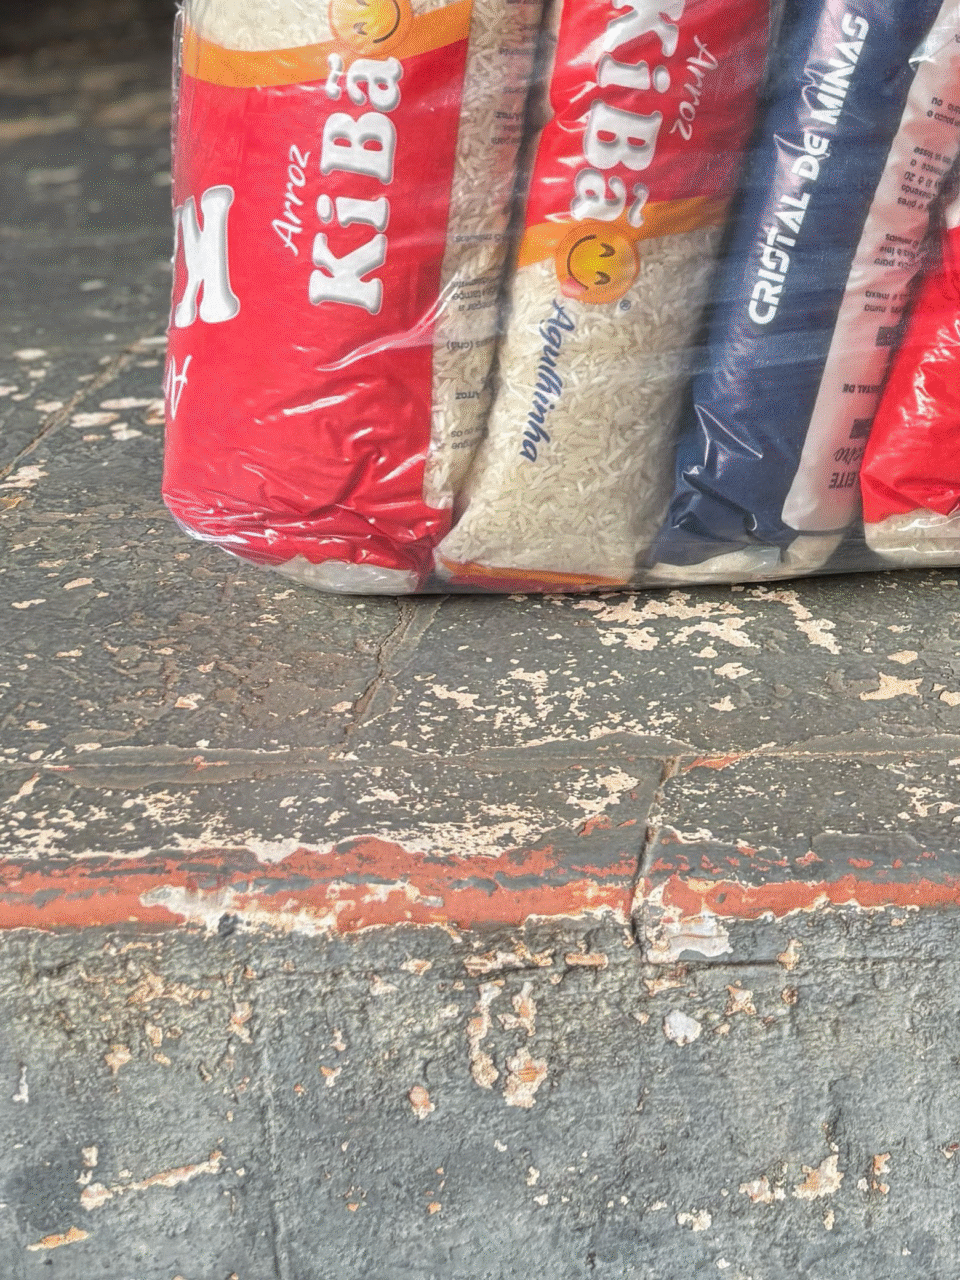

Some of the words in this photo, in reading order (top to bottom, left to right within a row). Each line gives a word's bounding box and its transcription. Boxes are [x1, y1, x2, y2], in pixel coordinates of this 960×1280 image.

[669, 35, 719, 141] Arroz
[810, 12, 869, 125] MINAS
[271, 144, 311, 256] Arroz
[792, 130, 830, 181] DE
[749, 192, 811, 324] CRISTAL
[520, 299, 578, 463] Agulhinha
